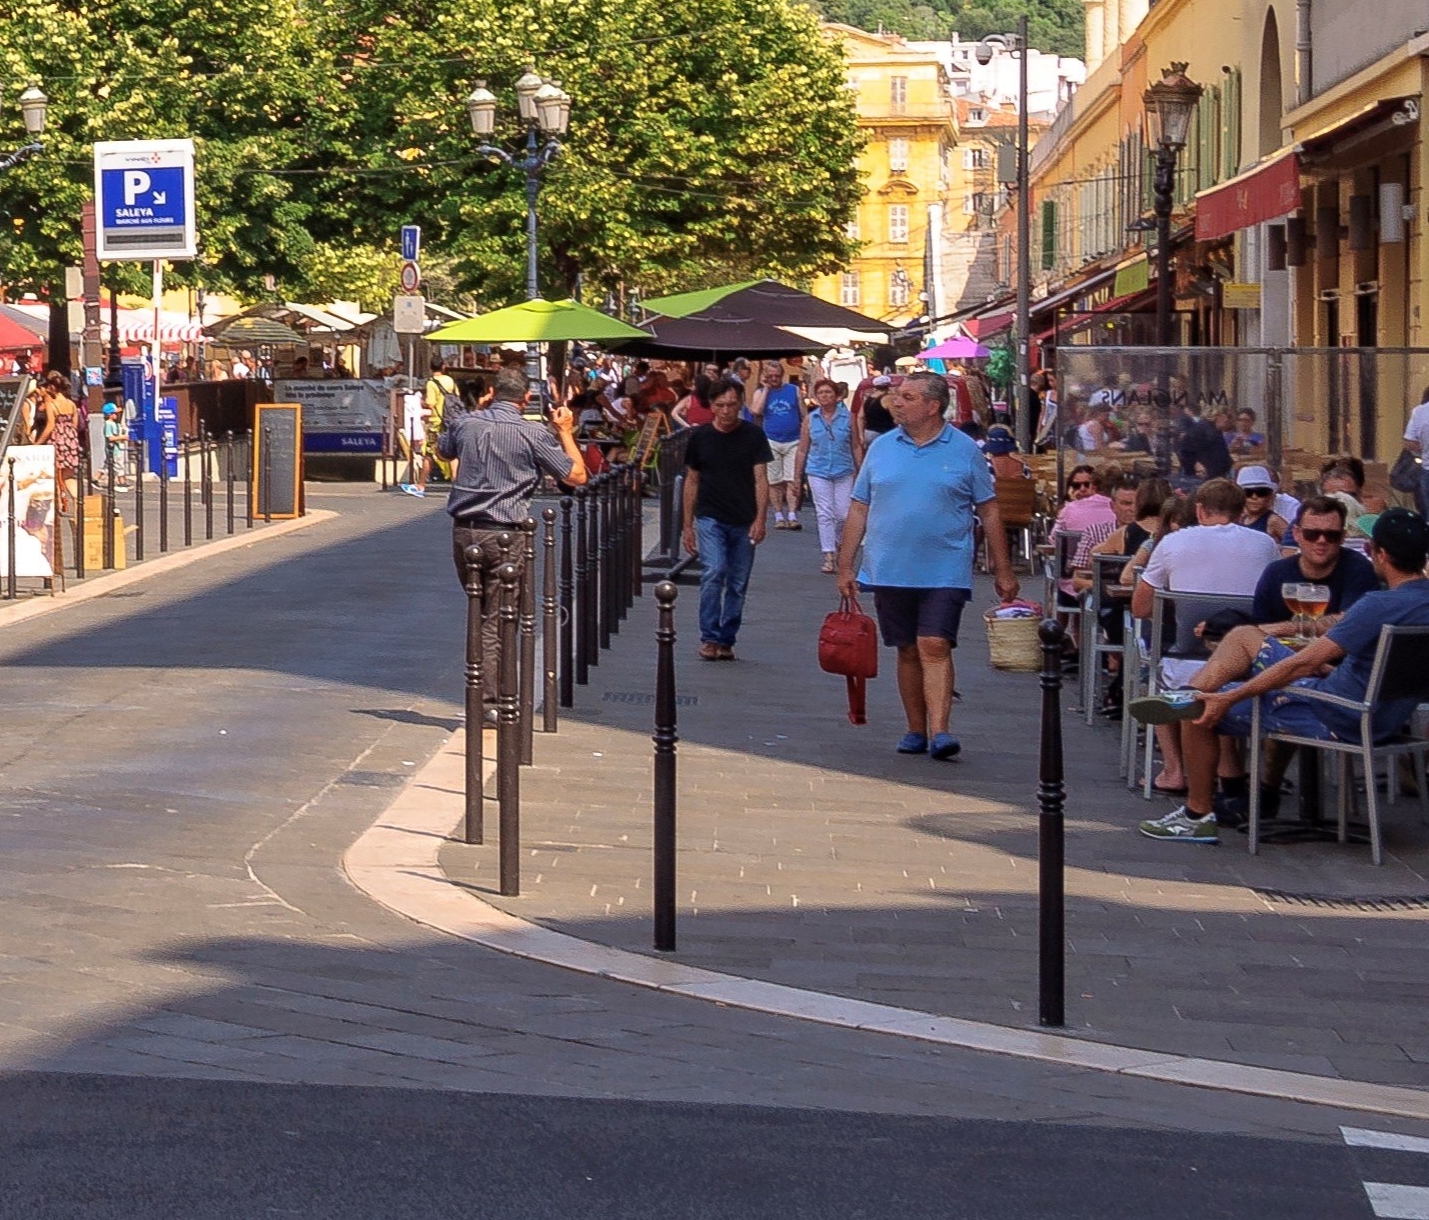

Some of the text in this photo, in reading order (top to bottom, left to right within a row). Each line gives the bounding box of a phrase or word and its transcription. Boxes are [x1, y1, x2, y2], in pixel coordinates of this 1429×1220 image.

[124, 170, 151, 205] P
[115, 208, 154, 218] SALEYA
[342, 438, 376, 446] SALEYA
